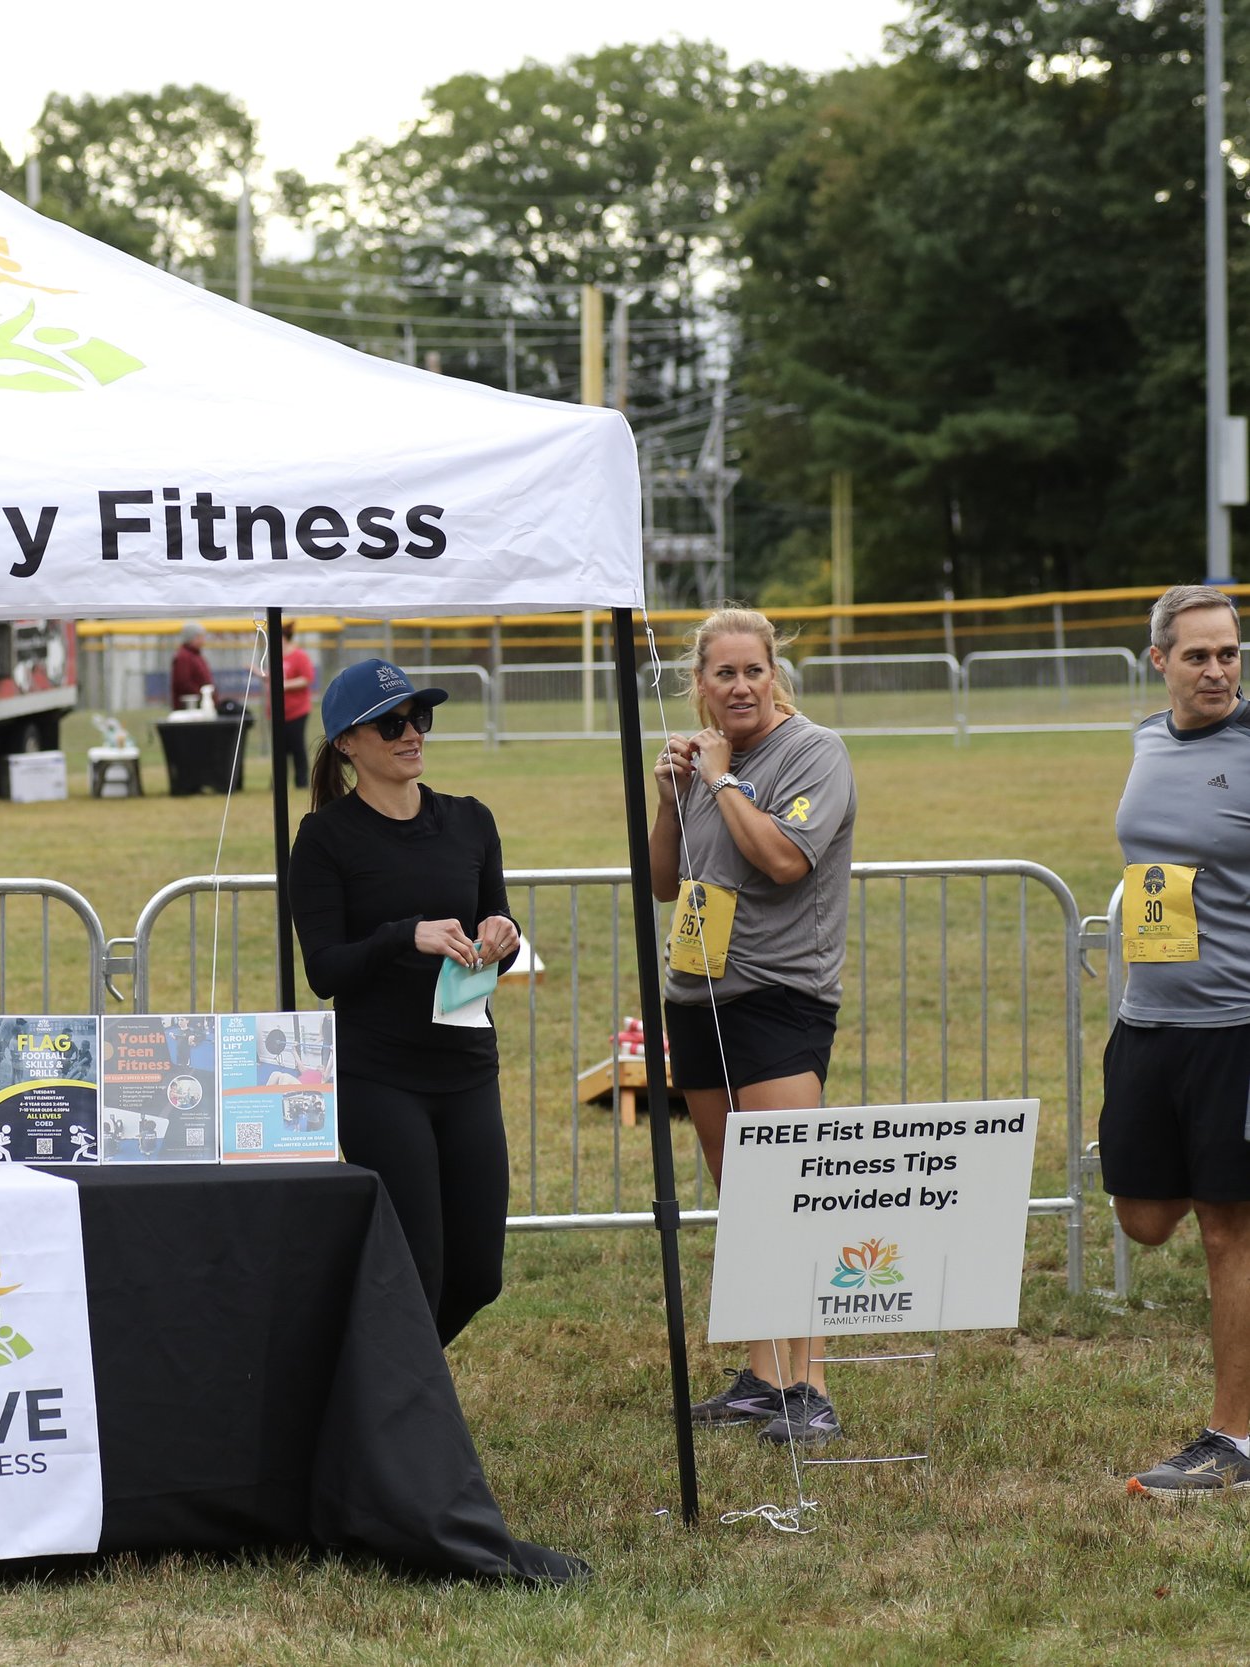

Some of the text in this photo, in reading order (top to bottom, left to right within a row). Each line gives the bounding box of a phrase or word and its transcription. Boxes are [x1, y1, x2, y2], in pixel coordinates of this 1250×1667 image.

[98, 487, 447, 562] Fitness
[379, 679, 407, 691] THRIVE
[1207, 780, 1229, 789] adidas
[1144, 899, 1163, 923] 30
[680, 913, 705, 937] 257
[17, 1034, 71, 1052] FLAG
[117, 1032, 166, 1044] Youth
[21, 1052, 66, 1060] FOOTBALL
[117, 1046, 154, 1057] Teen
[117, 1059, 171, 1071] Fitness
[30, 1069, 59, 1077] DRILLS
[739, 1113, 1025, 1146] FREE Fist Bumps and
[800, 1150, 957, 1178] Fitness Tips
[793, 1186, 959, 1213] Provided by:
[817, 1292, 913, 1315] THRIVE
[823, 1313, 904, 1326] FAMILY FITNESS
